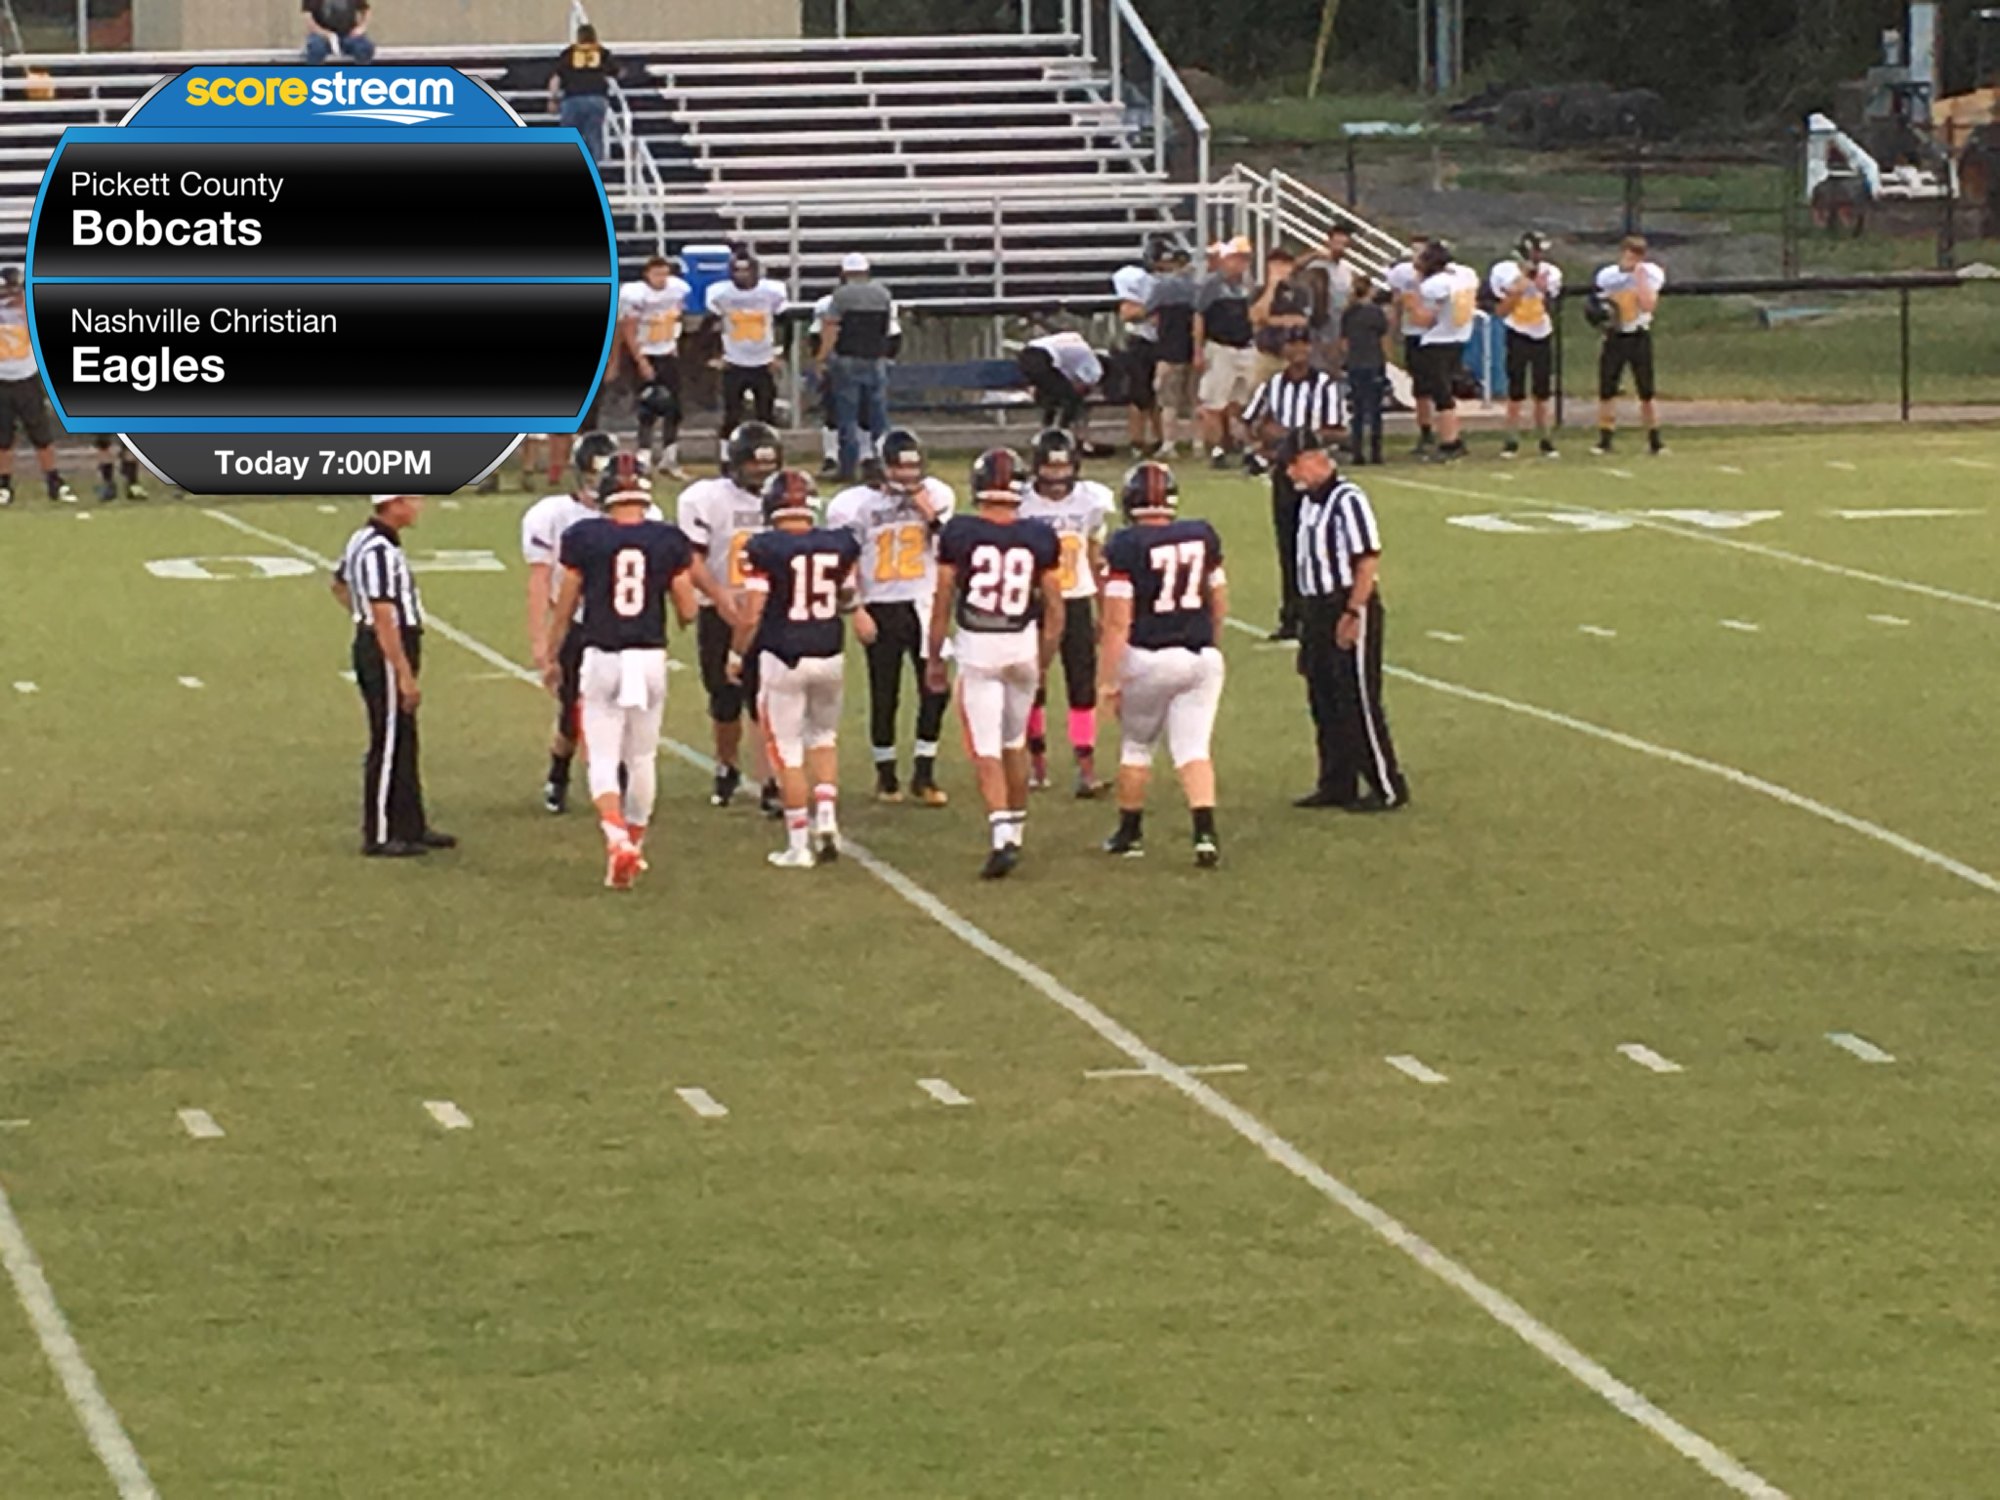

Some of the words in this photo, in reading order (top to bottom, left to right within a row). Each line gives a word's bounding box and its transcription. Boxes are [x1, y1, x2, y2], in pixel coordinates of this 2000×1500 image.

[614, 549, 646, 616] 8
[788, 553, 839, 621] 15
[875, 524, 925, 582] 12
[967, 546, 1034, 616] 28
[1151, 541, 1206, 612] 77
